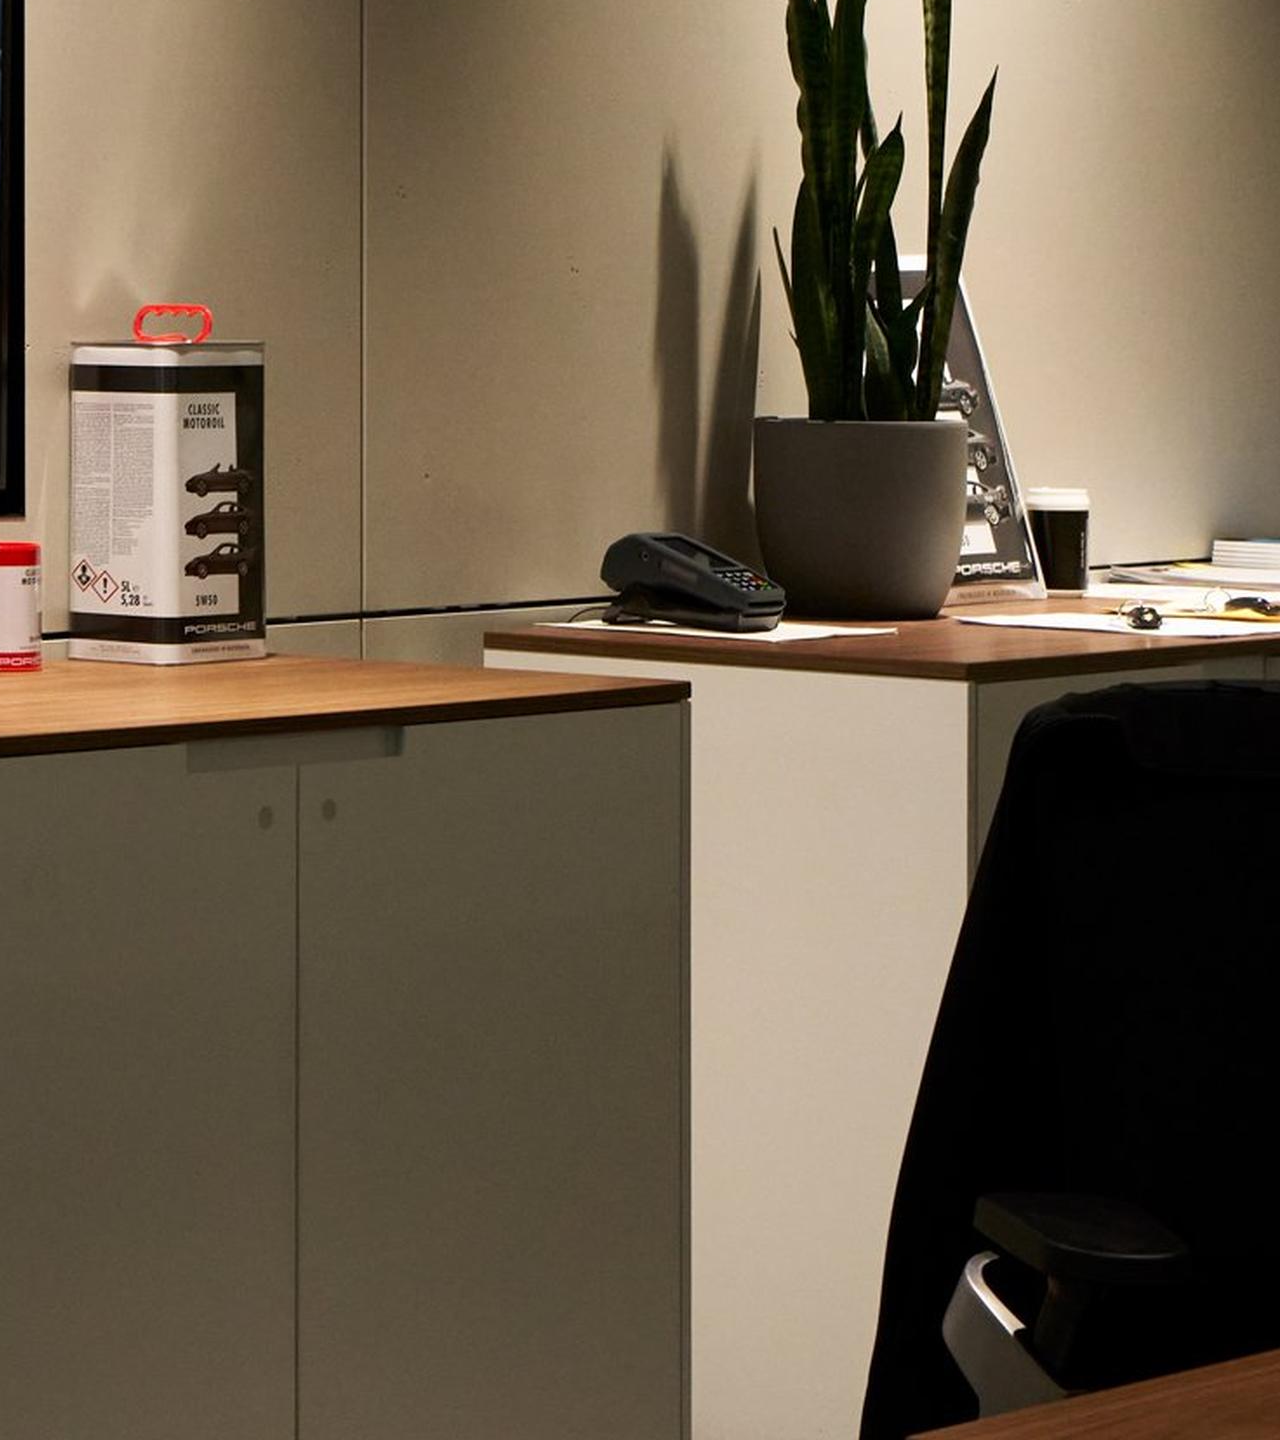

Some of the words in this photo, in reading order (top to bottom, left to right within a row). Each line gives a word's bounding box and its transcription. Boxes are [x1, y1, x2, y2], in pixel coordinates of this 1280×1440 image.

[187, 403, 221, 416] CLASSIC
[183, 417, 225, 430] MOTOROIL
[120, 593, 141, 608] 5,28
[196, 594, 219, 607] 5W50
[184, 621, 256, 636] PORSCHE
